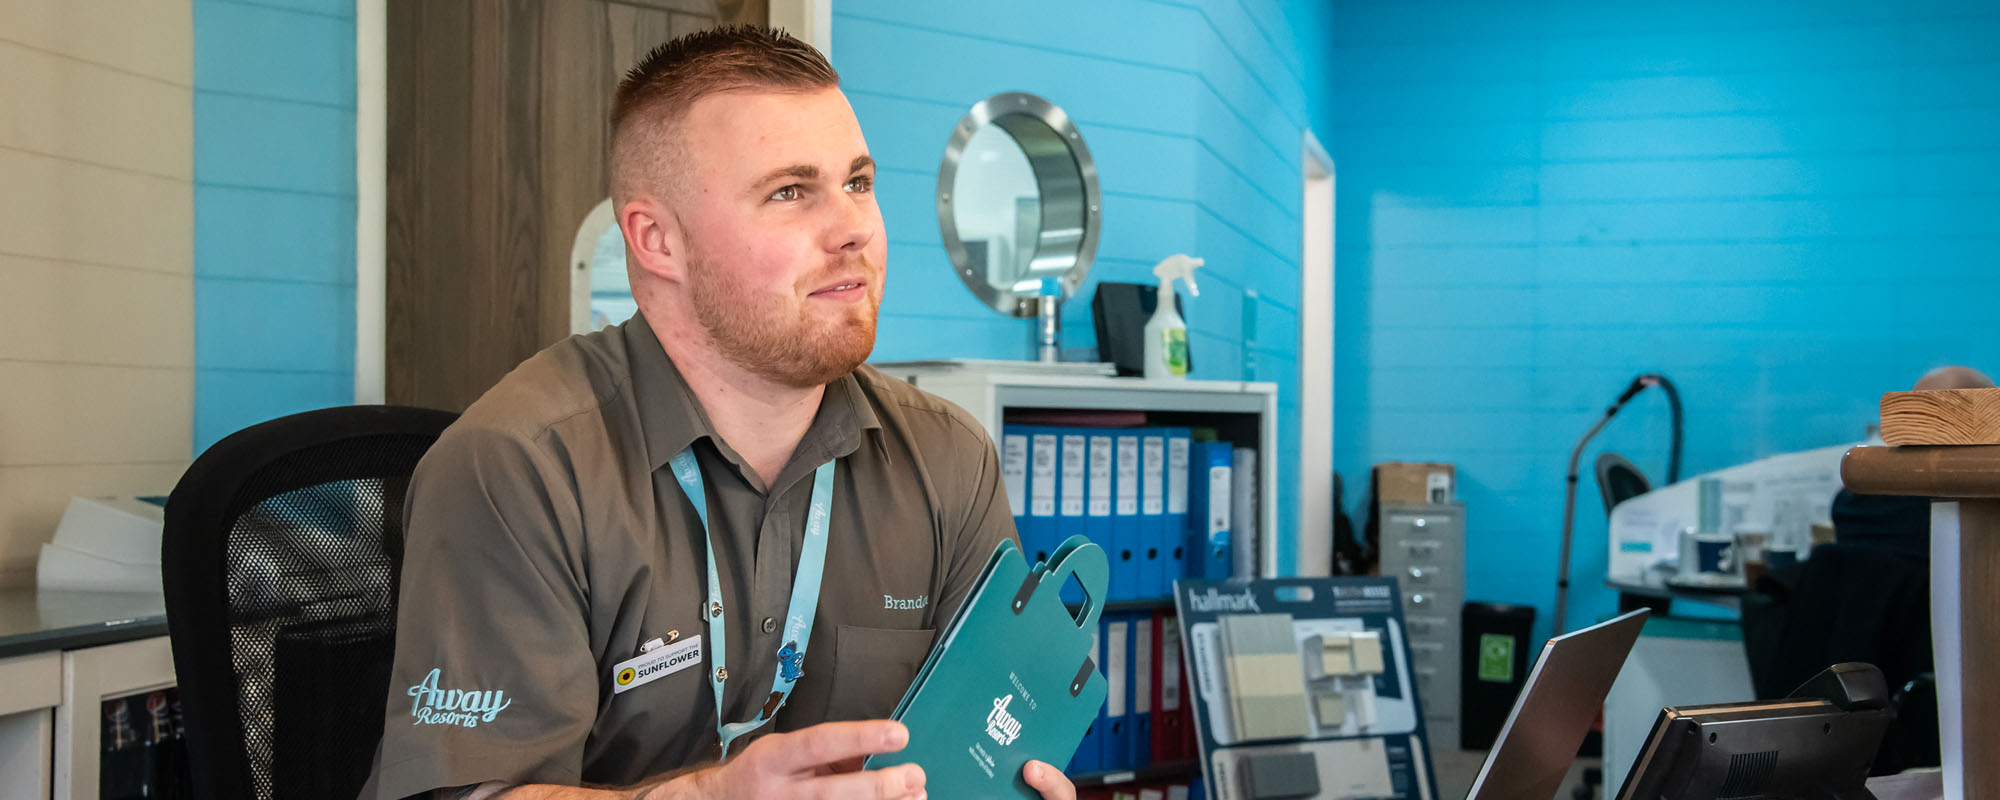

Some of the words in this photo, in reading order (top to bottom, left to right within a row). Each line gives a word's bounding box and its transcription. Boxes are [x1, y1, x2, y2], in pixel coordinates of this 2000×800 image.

[1188, 587, 1261, 613] hallmark
[638, 658, 657, 669] PROUD
[665, 647, 688, 660] SUPPORT
[689, 643, 699, 651] THE
[638, 649, 699, 678] SUNFLOWER
[407, 668, 512, 723] Away
[1009, 672, 1031, 702] WELCOME
[1030, 699, 1037, 710] TO
[412, 707, 479, 728] Resorts
[986, 694, 1022, 745] Away
